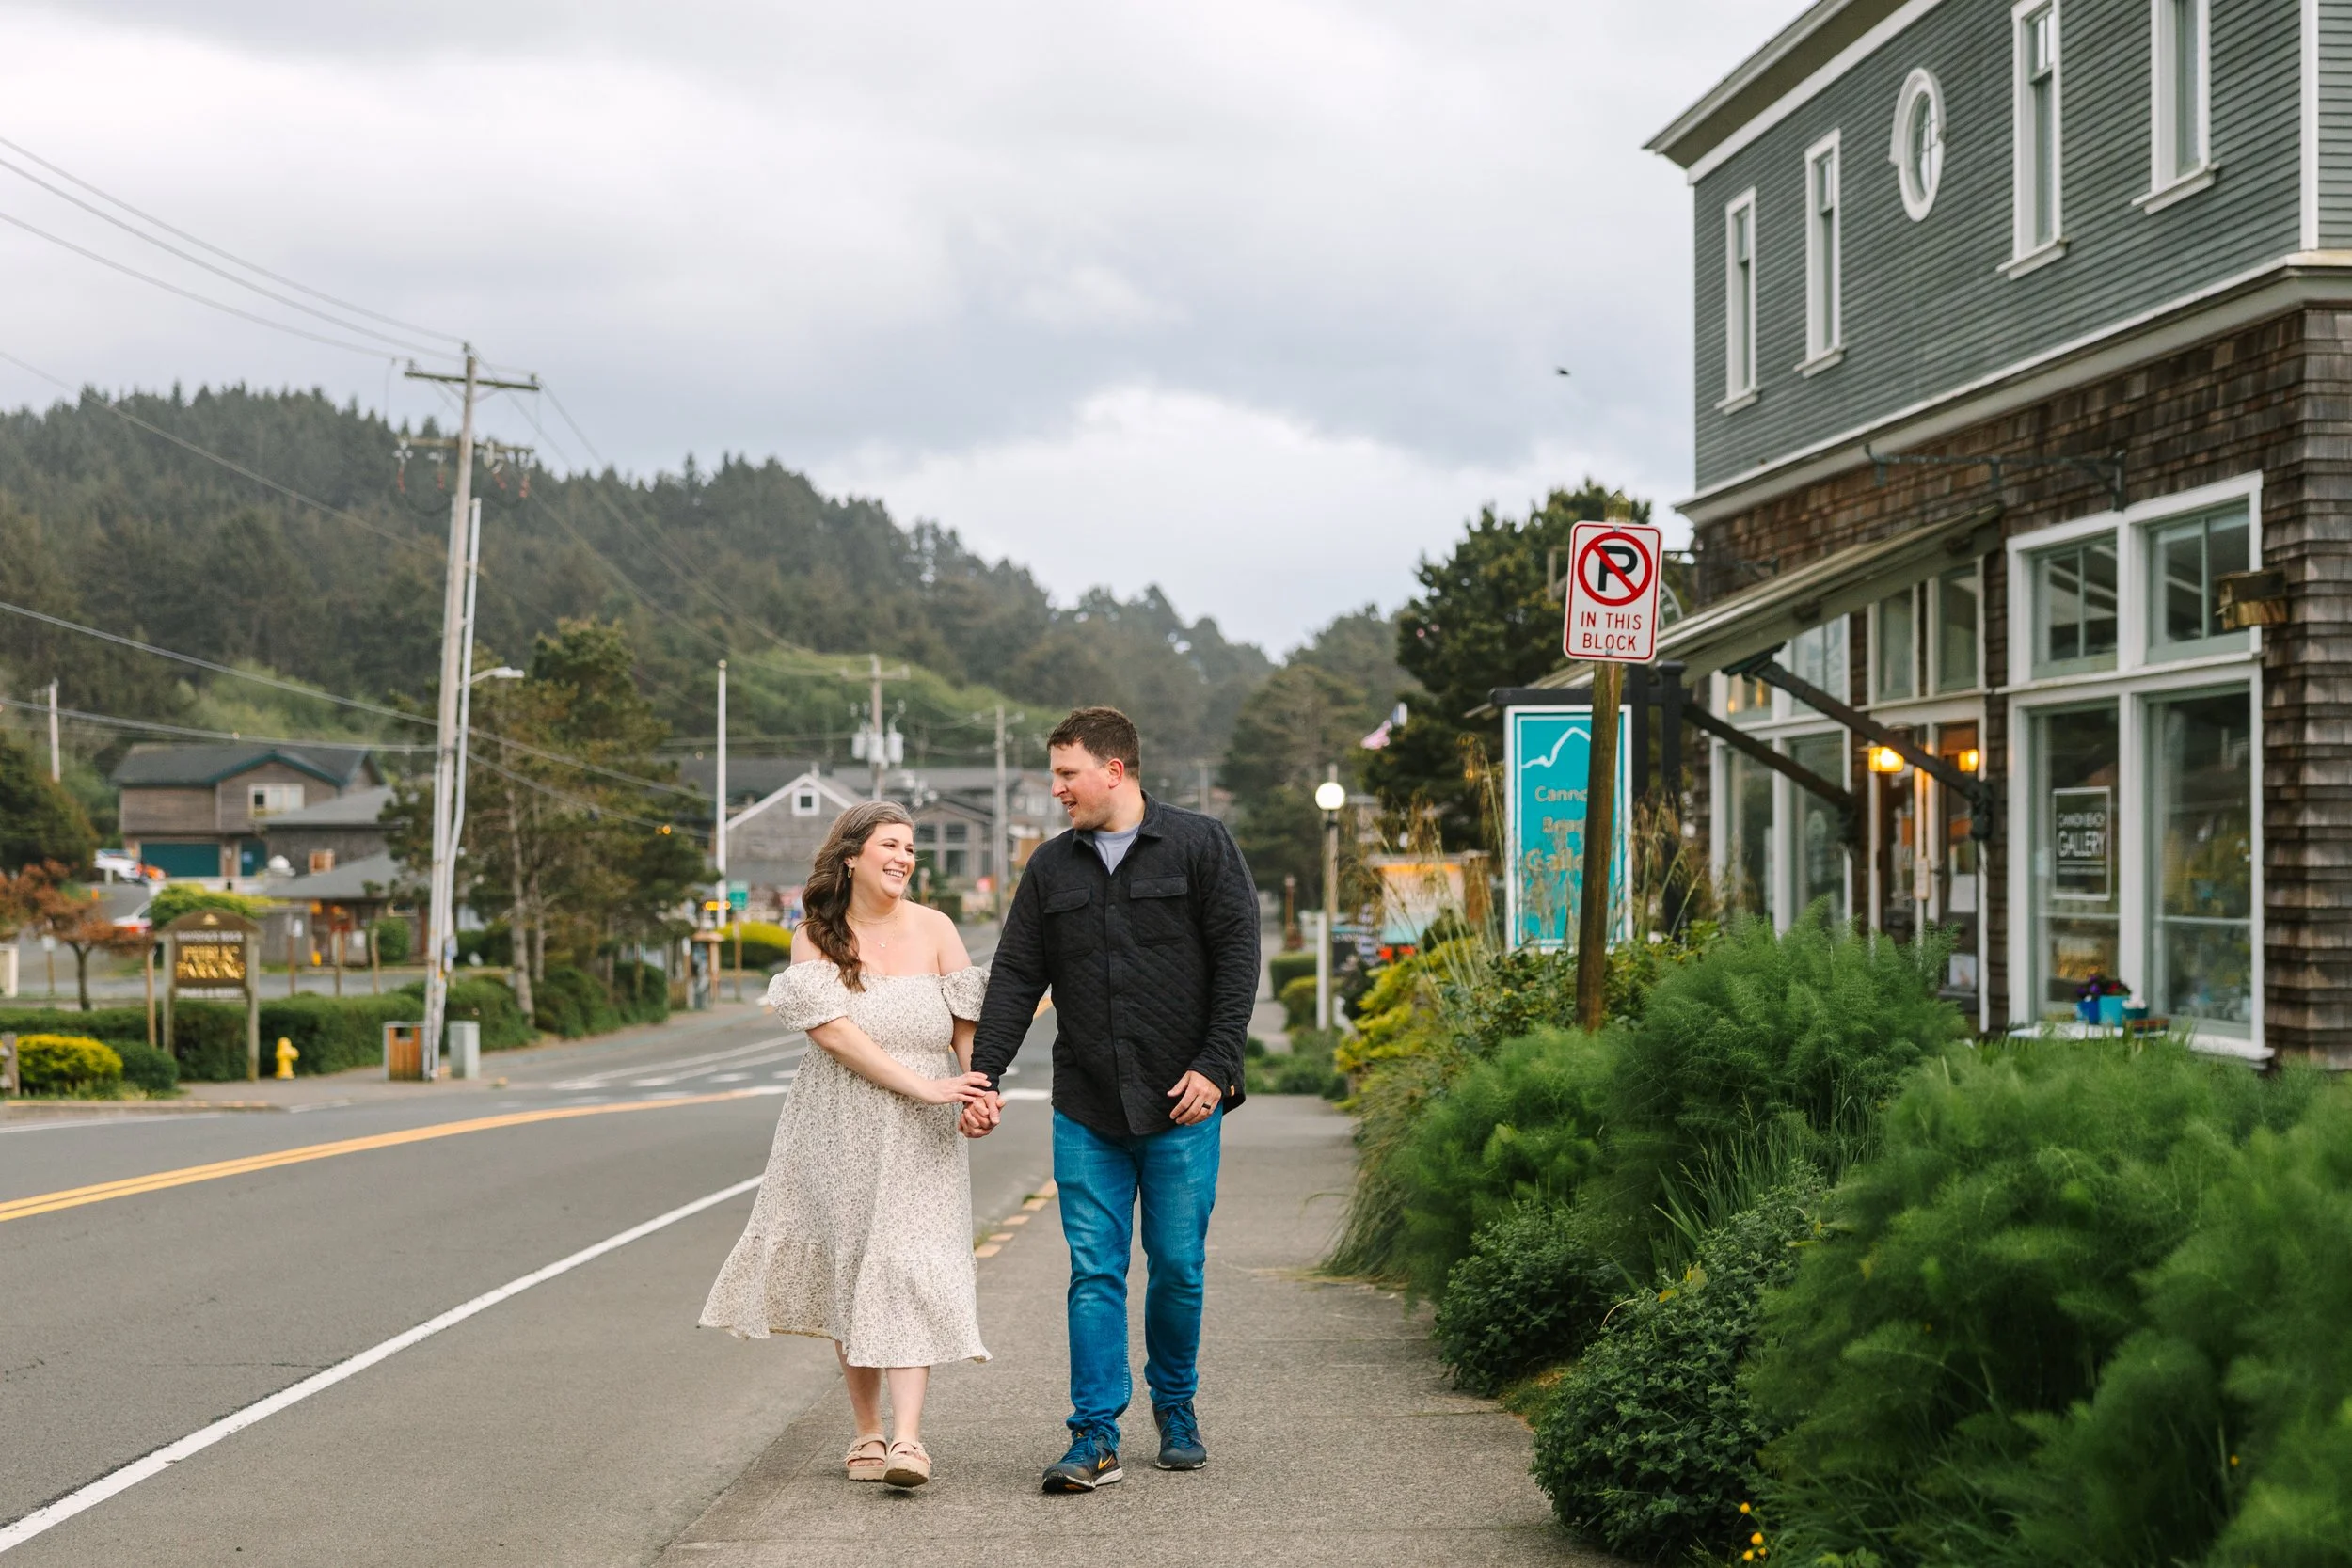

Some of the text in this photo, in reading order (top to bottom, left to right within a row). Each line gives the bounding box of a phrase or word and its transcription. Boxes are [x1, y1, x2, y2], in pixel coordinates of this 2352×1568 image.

[1581, 610, 1643, 631] IN THIS
[1582, 632, 1637, 652] BLOCK
[1534, 785, 1589, 802] Canno
